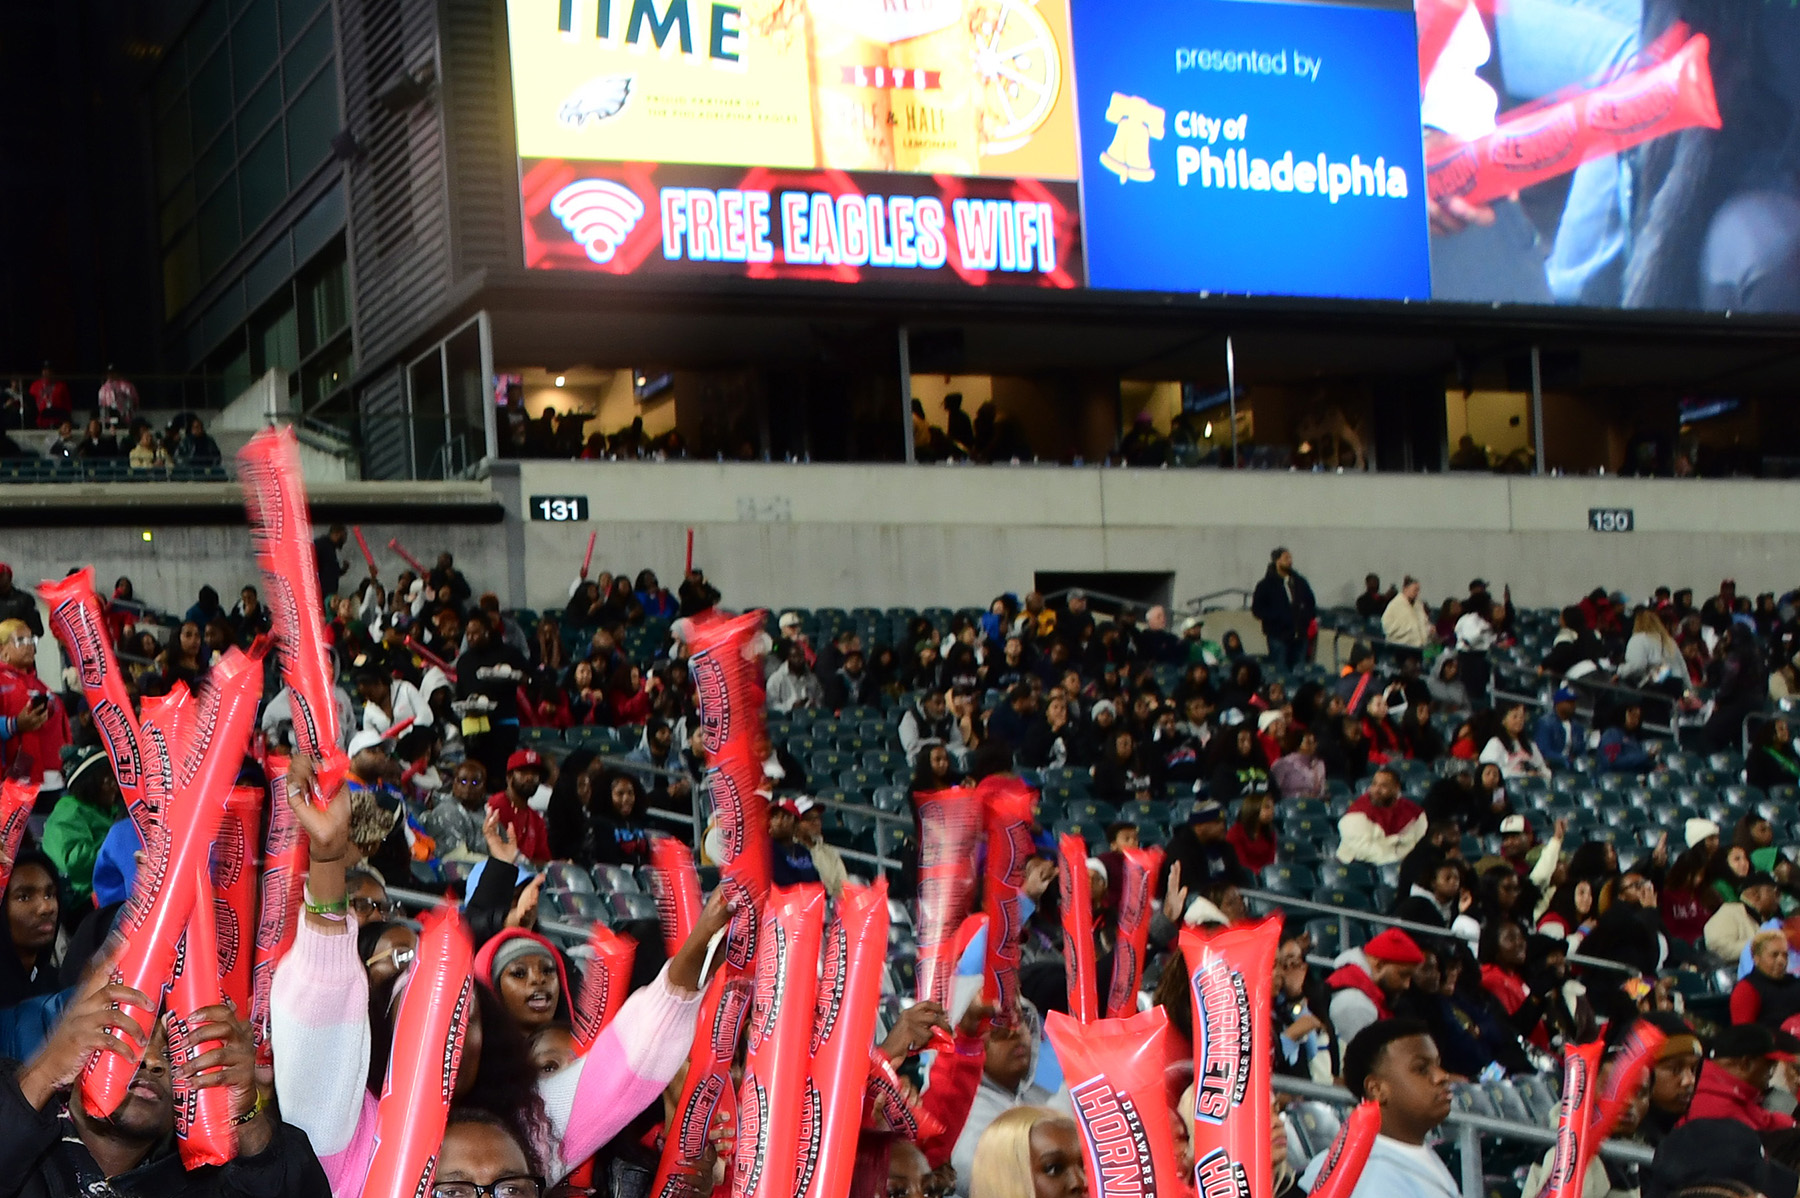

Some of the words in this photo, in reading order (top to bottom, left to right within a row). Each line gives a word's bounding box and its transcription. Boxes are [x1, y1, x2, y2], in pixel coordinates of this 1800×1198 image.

[1175, 47, 1287, 74] presented
[1292, 52, 1322, 82] by
[1174, 112, 1219, 143] City
[1222, 114, 1247, 140] of
[1177, 147, 1408, 202] Philadelphia
[661, 188, 773, 264] FREE
[780, 192, 947, 269] EAGLES
[954, 200, 1056, 274] WIFI
[539, 500, 578, 521] 131
[1594, 512, 1628, 531] 130
[62, 602, 100, 684] HORNETS
[203, 694, 221, 750] DELAWARE
[694, 657, 722, 752] HORNETS
[98, 704, 136, 785] HORNETS
[185, 755, 203, 785] STATE
[709, 773, 736, 863] HORNETS
[154, 836, 171, 891] DELAWARE
[136, 897, 156, 928] STATE
[752, 920, 778, 1053] HORNETS
[811, 923, 839, 1056] HORNETS
[835, 934, 846, 999] DELAWARE
[442, 1019, 457, 1096] DELAWARE
[454, 981, 469, 1017] STATE
[766, 1002, 781, 1036] STATE
[822, 1002, 839, 1041] STATE
[1198, 967, 1241, 1118] HORNETS
[1234, 979, 1249, 1052] DELAWARE
[1233, 1055, 1249, 1101] STATE
[685, 1078, 724, 1159] HORNETS
[757, 1091, 769, 1159] DELAWARE
[809, 1095, 822, 1162] DELAWARE
[1122, 1101, 1153, 1185] DELAWARE
[415, 1160, 434, 1197] STATE
[748, 1160, 764, 1197] STATE
